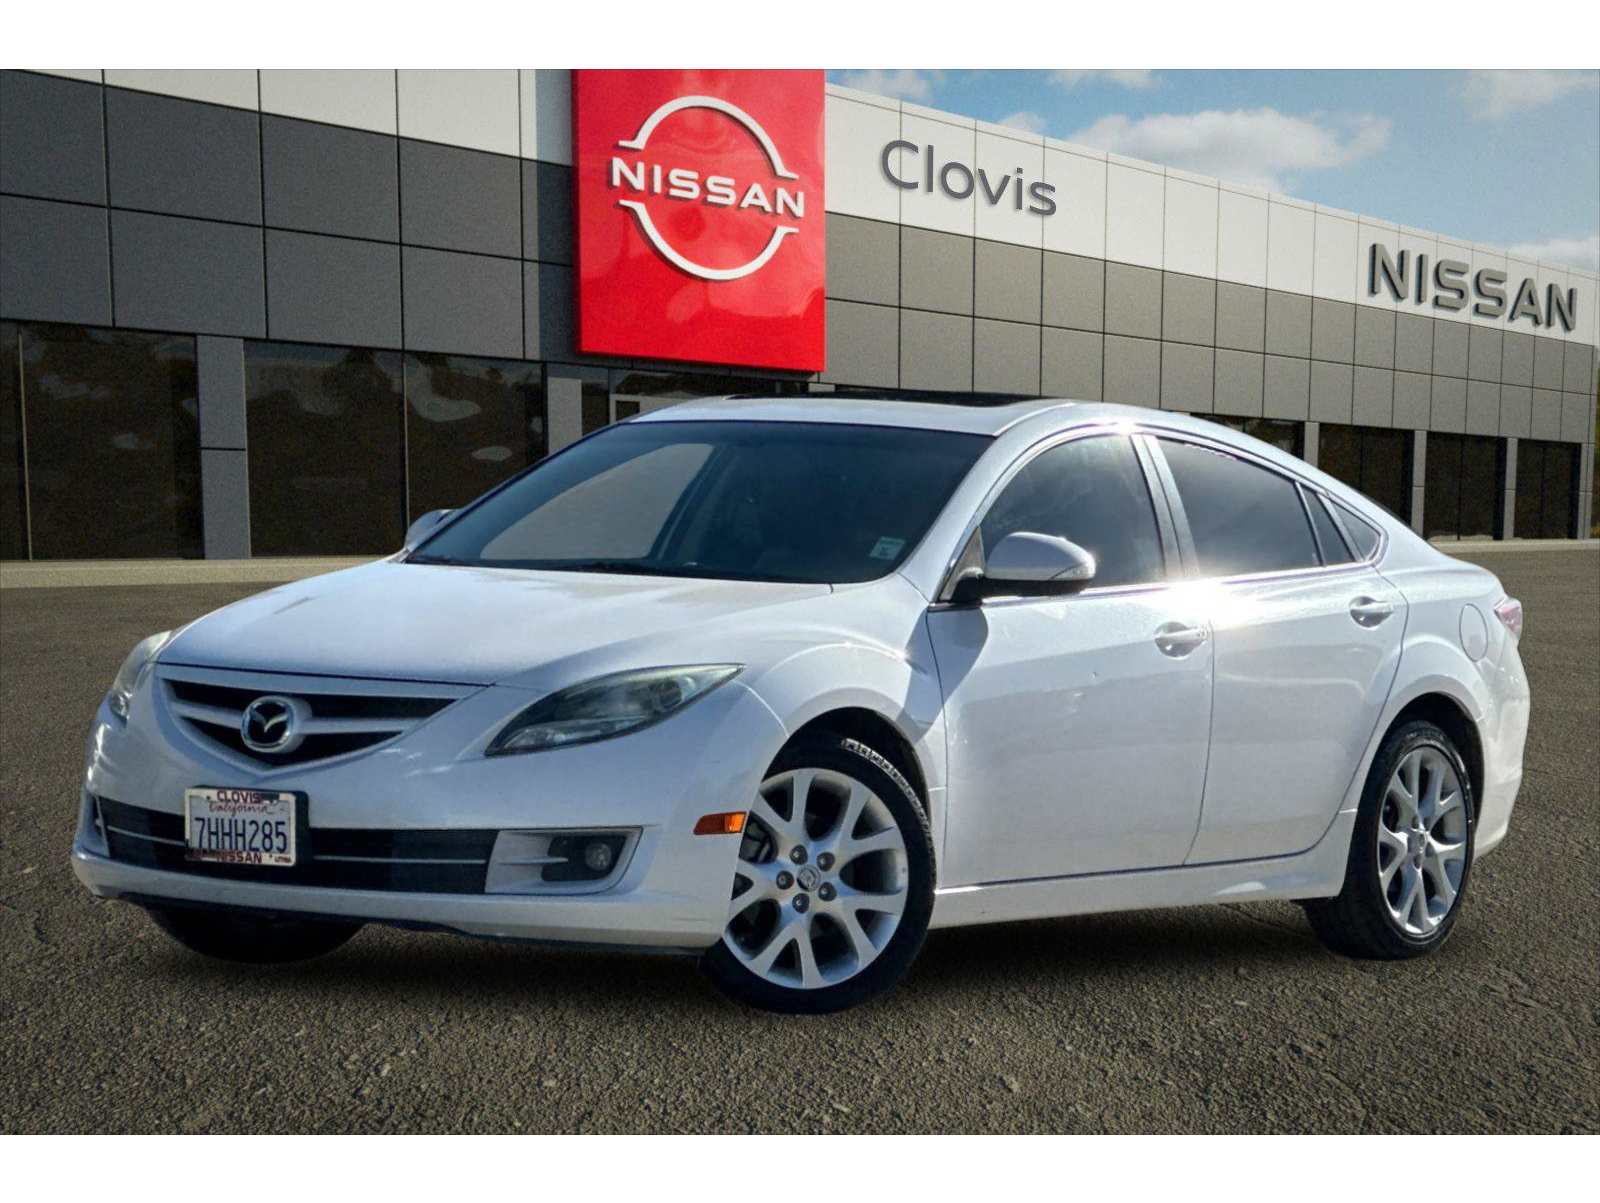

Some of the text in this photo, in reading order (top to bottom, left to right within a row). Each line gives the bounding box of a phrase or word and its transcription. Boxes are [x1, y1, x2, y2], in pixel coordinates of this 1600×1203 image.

[611, 156, 805, 218] NISSAN
[882, 139, 1057, 216] Clovis
[1368, 243, 1578, 332] NISSAN
[216, 790, 262, 804] CLOVIS
[194, 817, 287, 854] 7HHH285
[217, 849, 263, 864] NISSAN
